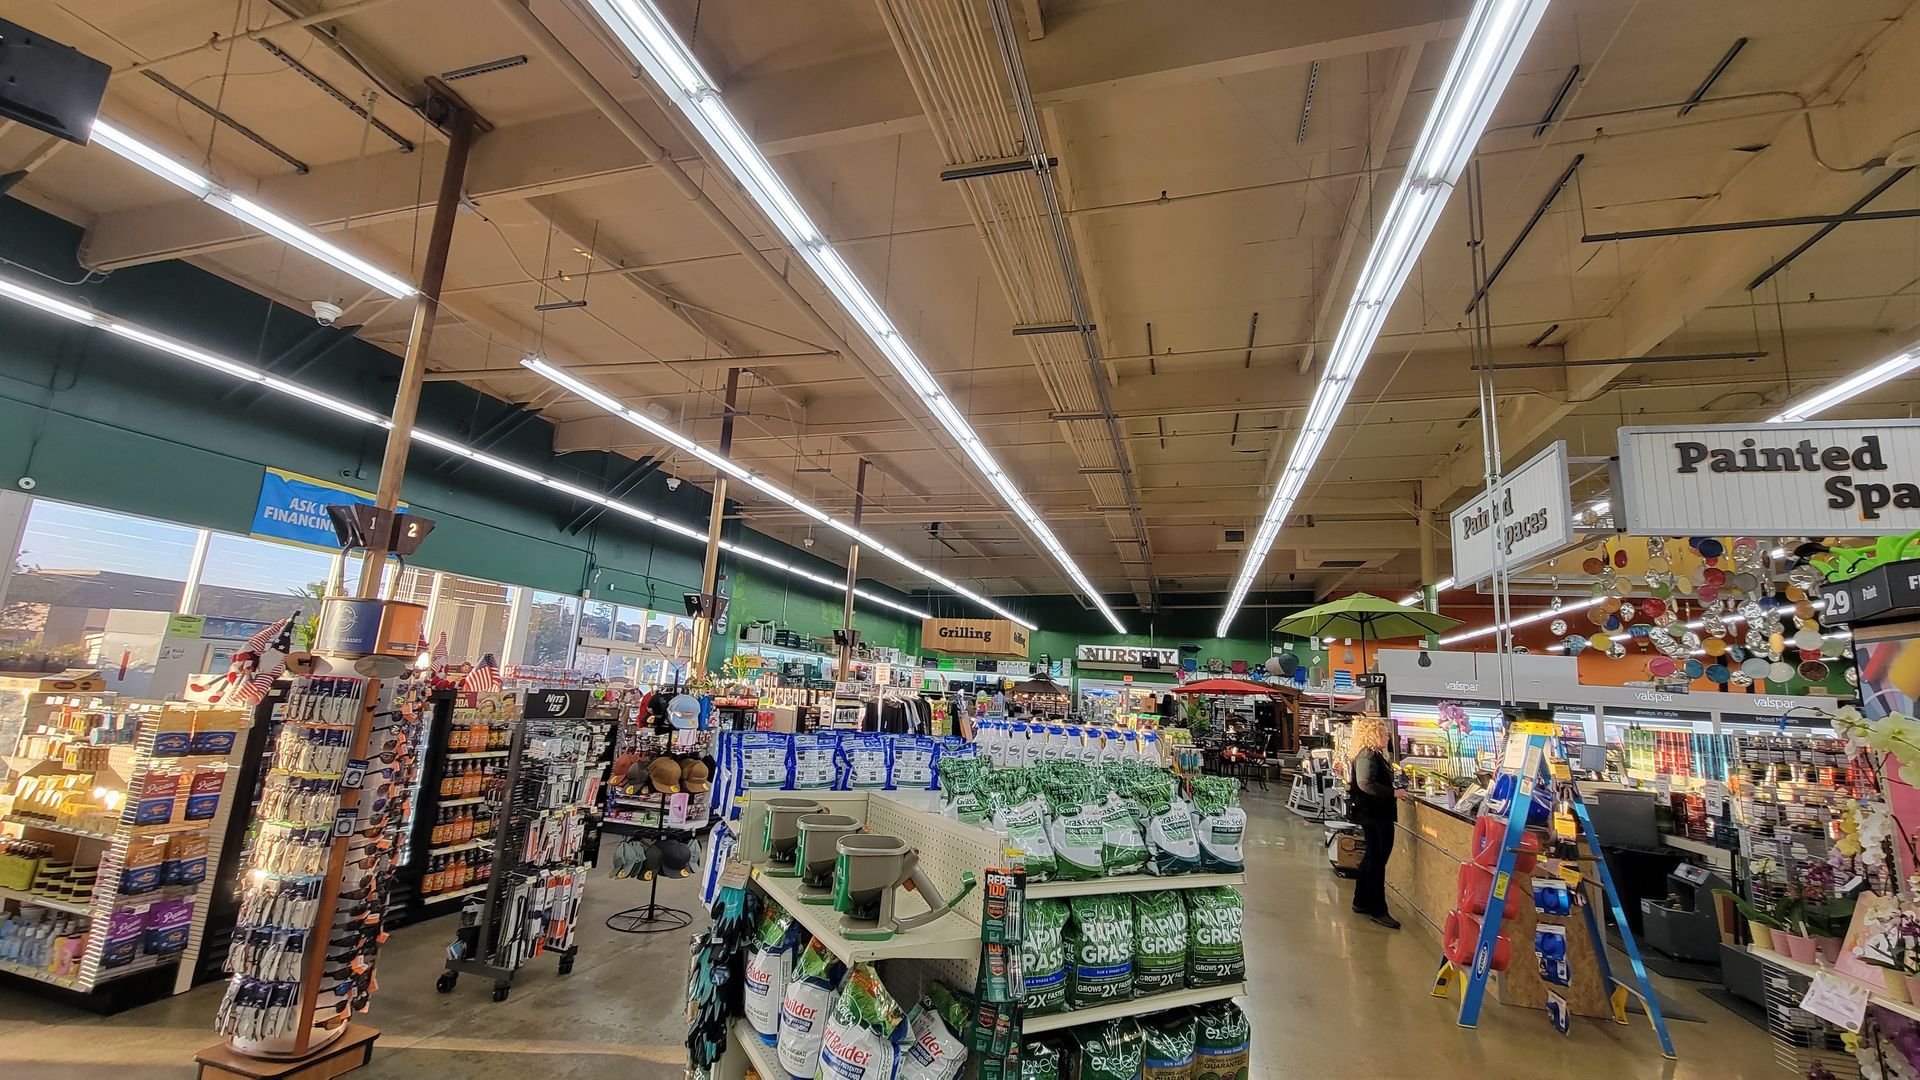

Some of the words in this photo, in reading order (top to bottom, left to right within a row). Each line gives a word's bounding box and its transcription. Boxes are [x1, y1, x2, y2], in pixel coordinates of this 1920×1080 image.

[1674, 435, 1888, 474] Painted
[289, 497, 317, 513] ASK
[319, 503, 331, 516] U
[370, 517, 376, 530] 1
[407, 522, 417, 537] 2
[690, 596, 698, 604] 3
[1823, 590, 1850, 616] 29
[939, 627, 992, 642] Grilling
[1374, 675, 1385, 684] 27
[1444, 681, 1480, 693] valspar
[545, 694, 566, 703] NITE
[1634, 691, 1673, 703] valspar
[1753, 697, 1796, 710] valspar
[548, 703, 562, 712] IZE
[1565, 705, 1589, 713] inspired
[957, 797, 976, 805] Grass
[1064, 819, 1086, 827] Grass
[987, 874, 1017, 887] REPEL
[988, 884, 1007, 897] 100
[1140, 913, 1186, 937] RAPID
[1197, 928, 1241, 945] GRAS
[1022, 948, 1063, 972] RASS
[1478, 947, 1487, 972] WERNER
[1217, 964, 1232, 977] 2X
[1140, 974, 1160, 982] GROWS
[1160, 973, 1175, 987] 2X
[1077, 985, 1102, 993] GROWS
[1102, 984, 1118, 998] 2X
[1028, 994, 1048, 1009] 2X
[920, 1029, 945, 1057] lder
